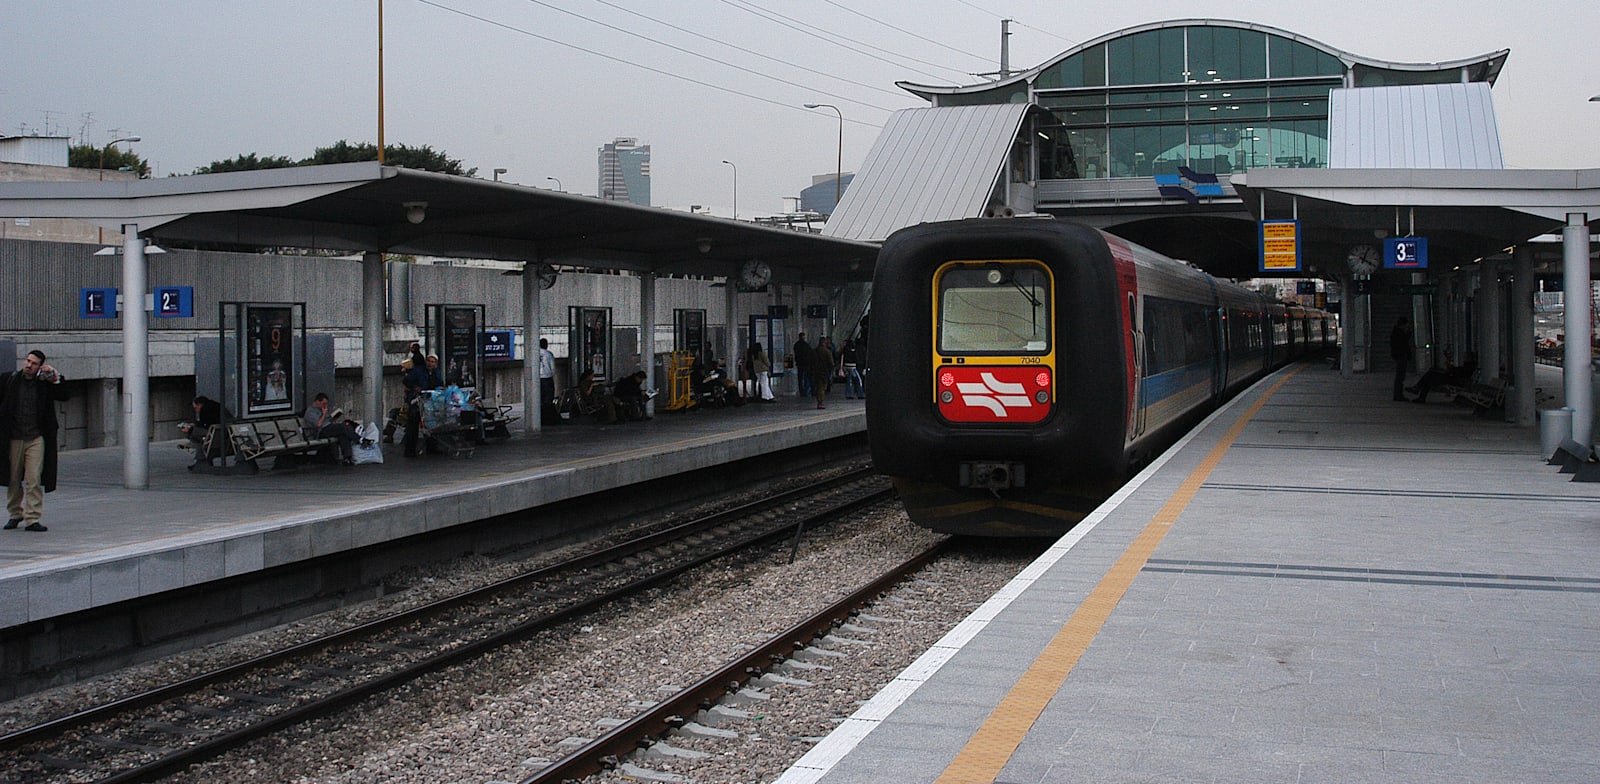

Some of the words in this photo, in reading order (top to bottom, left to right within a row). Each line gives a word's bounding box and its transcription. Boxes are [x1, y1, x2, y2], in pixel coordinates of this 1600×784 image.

[1397, 243, 1406, 261] 3
[88, 293, 94, 311] 1
[163, 292, 170, 310] 2
